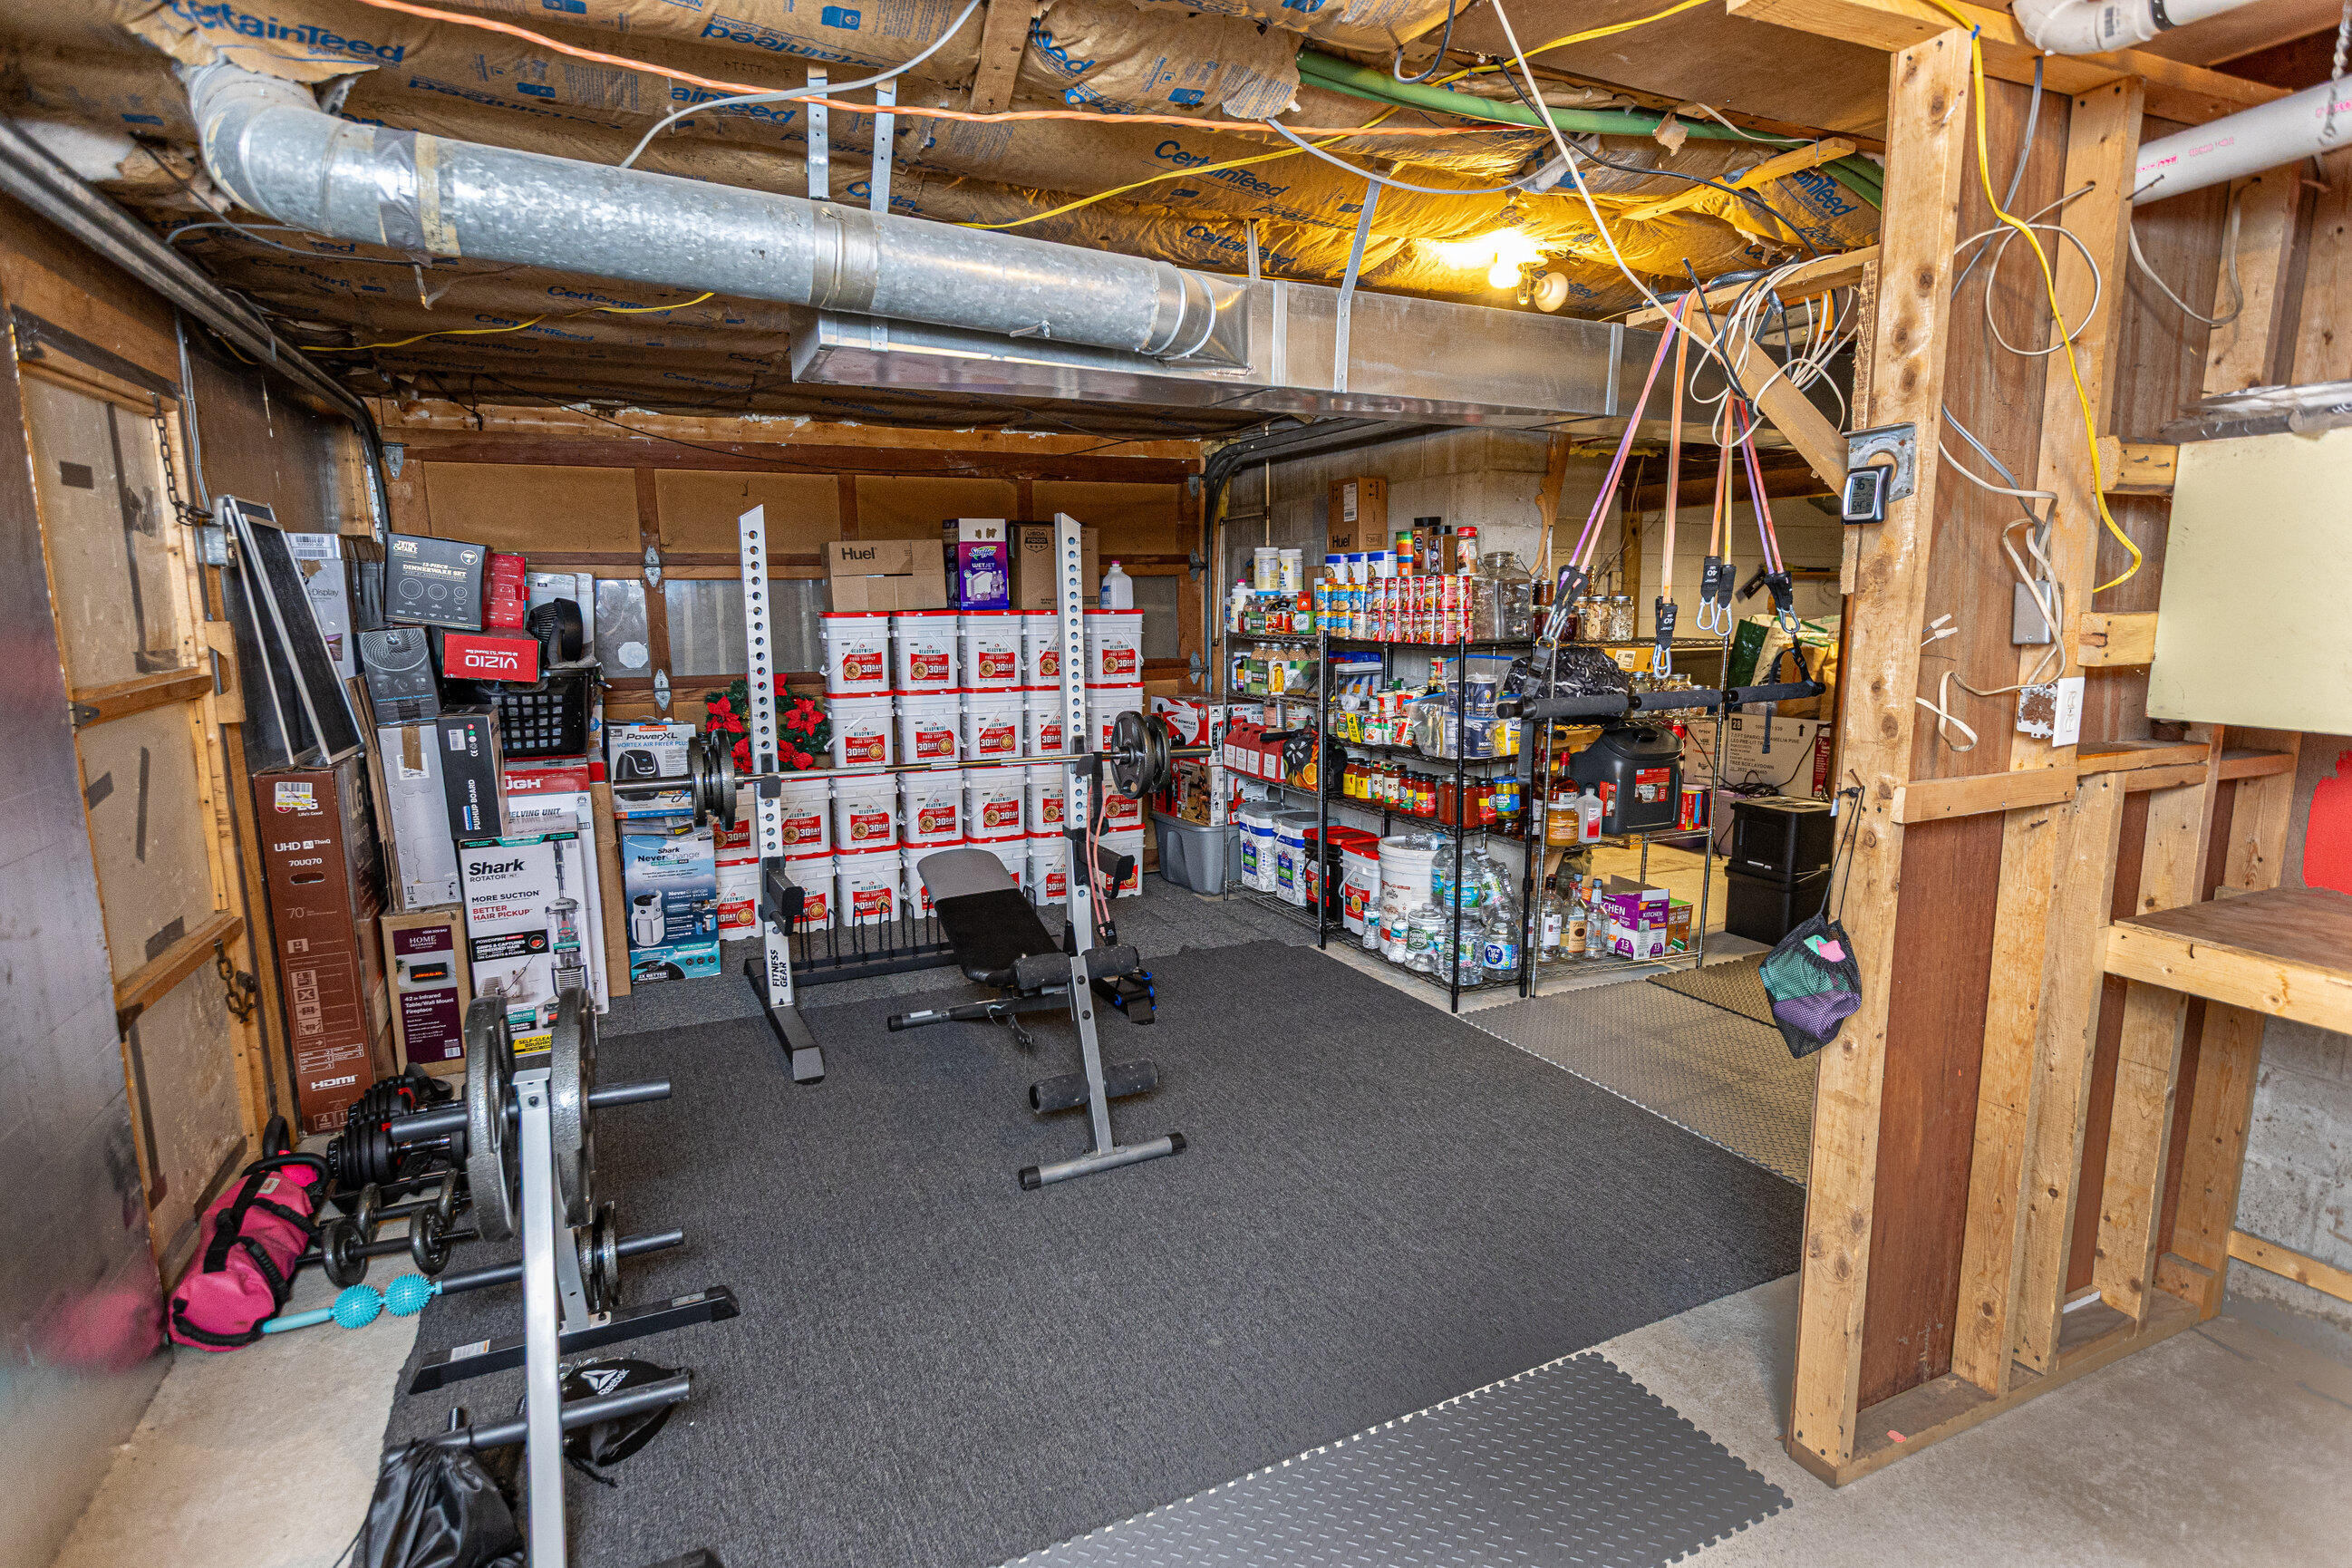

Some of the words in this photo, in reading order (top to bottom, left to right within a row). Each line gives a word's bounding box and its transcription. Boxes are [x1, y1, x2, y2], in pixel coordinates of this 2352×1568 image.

[1332, 534, 1350, 548] Huel
[841, 547, 876, 560] Huel
[968, 547, 996, 558] Swiffer
[403, 565, 452, 576] DINNERWARE
[313, 588, 339, 597] Display
[465, 654, 518, 669] VIZIO
[861, 664, 872, 673] 30
[928, 665, 938, 673] 30
[996, 663, 1005, 671] 30
[1732, 719, 1742, 730] 28
[626, 732, 679, 741] PowerXL
[917, 743, 928, 751] 30
[981, 739, 990, 747] 30
[847, 749, 857, 757] 30
[469, 779, 479, 804] BOARD
[469, 804, 481, 830] PUSHUP
[542, 808, 561, 816] UNIT
[728, 833, 738, 841] 30
[799, 828, 809, 837] 30
[274, 841, 301, 852] UHD
[288, 857, 323, 867] 70UQ70
[637, 852, 700, 862] NeverChange
[469, 859, 526, 876] Shark
[469, 874, 507, 882] ROTATOR
[1047, 883, 1057, 891] 30
[471, 894, 498, 904] MORE
[499, 891, 540, 900] SUCTION
[286, 906, 305, 919] 70
[472, 905, 508, 915] BETTER
[1602, 902, 1626, 915] CHEN
[473, 913, 497, 921] HAIR
[498, 909, 530, 919] PICKUP
[410, 935, 437, 944] HOME
[1621, 939, 1630, 948] 13
[770, 949, 779, 987] FITNESS
[779, 962, 788, 987] GEAR
[518, 1035, 552, 1044] SELF-CLEA
[311, 1074, 358, 1089] HDMI
[597, 1369, 630, 1395] Reebok
